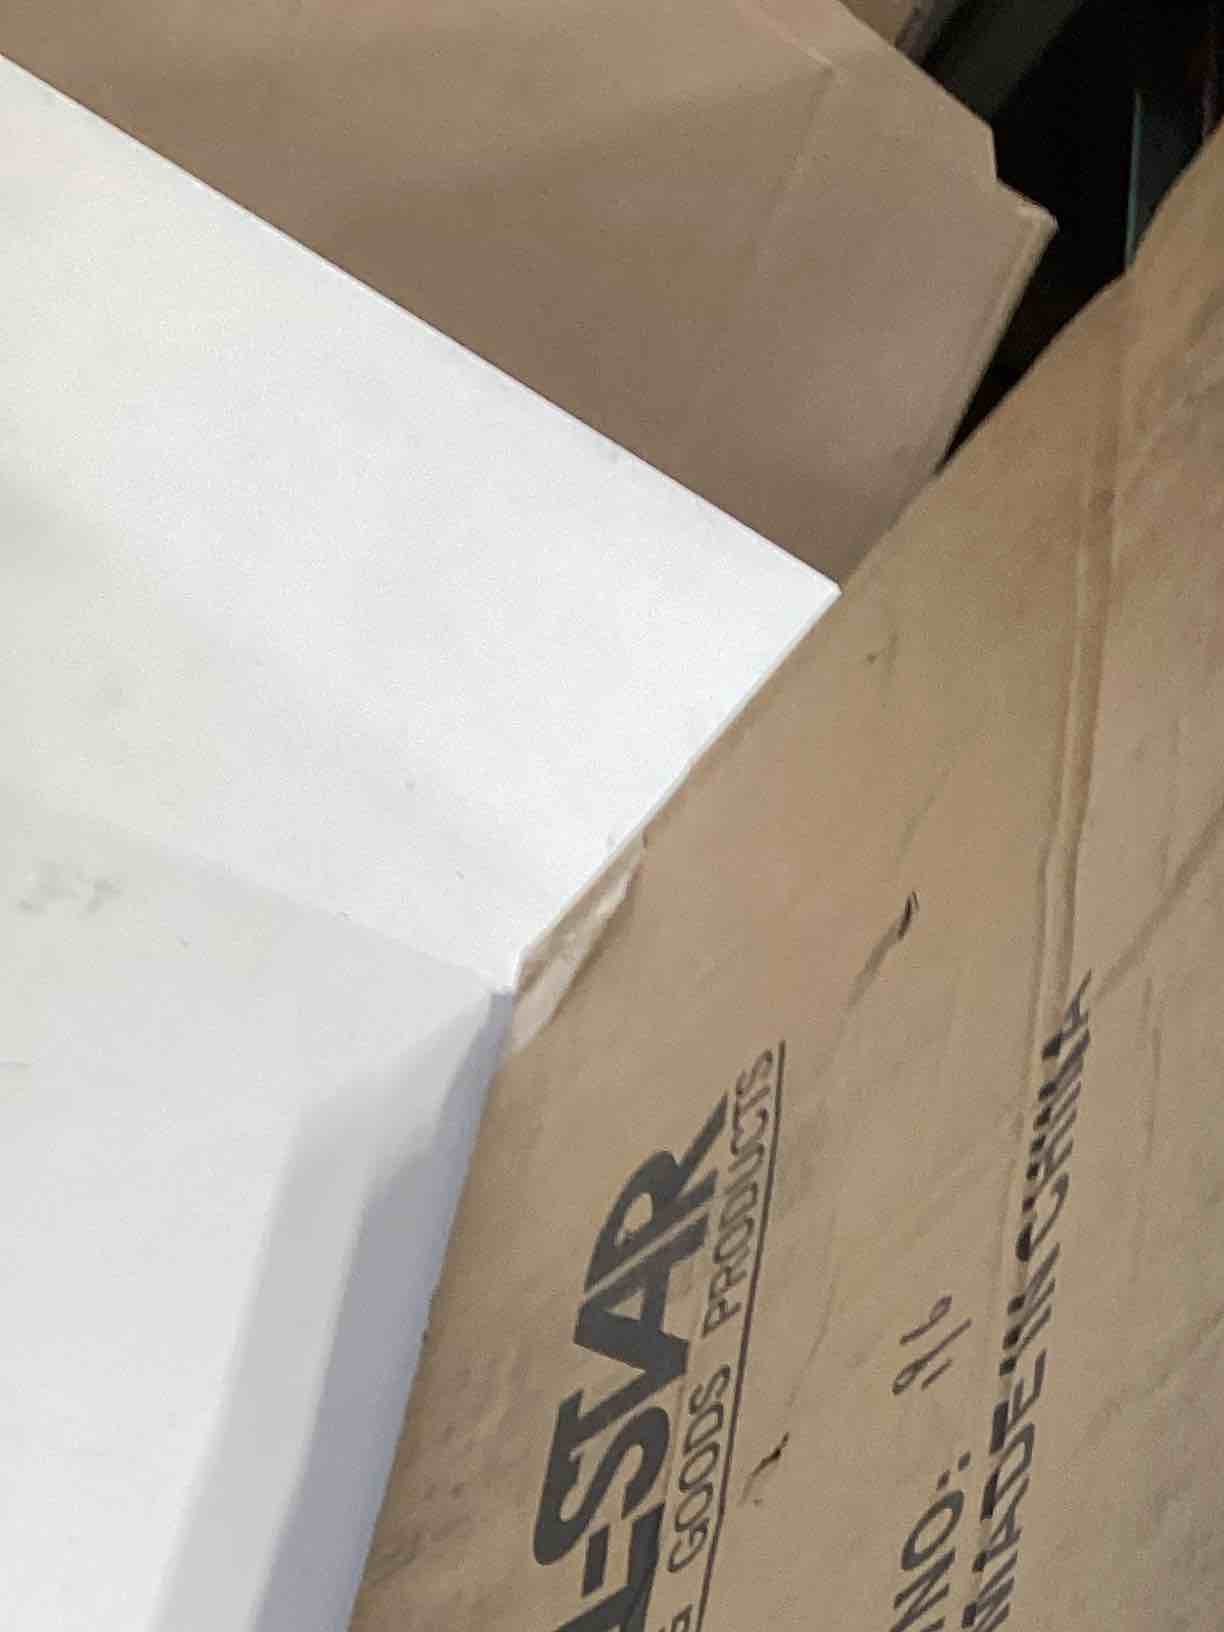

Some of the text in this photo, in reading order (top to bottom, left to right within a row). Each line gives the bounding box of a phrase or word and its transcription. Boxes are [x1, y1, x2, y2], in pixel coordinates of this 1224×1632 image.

[1015, 968, 1092, 1263] CHINA
[668, 1364, 730, 1575] GOODS
[702, 1047, 775, 1340] PRODUCTS
[1000, 1242, 1060, 1377] IN
